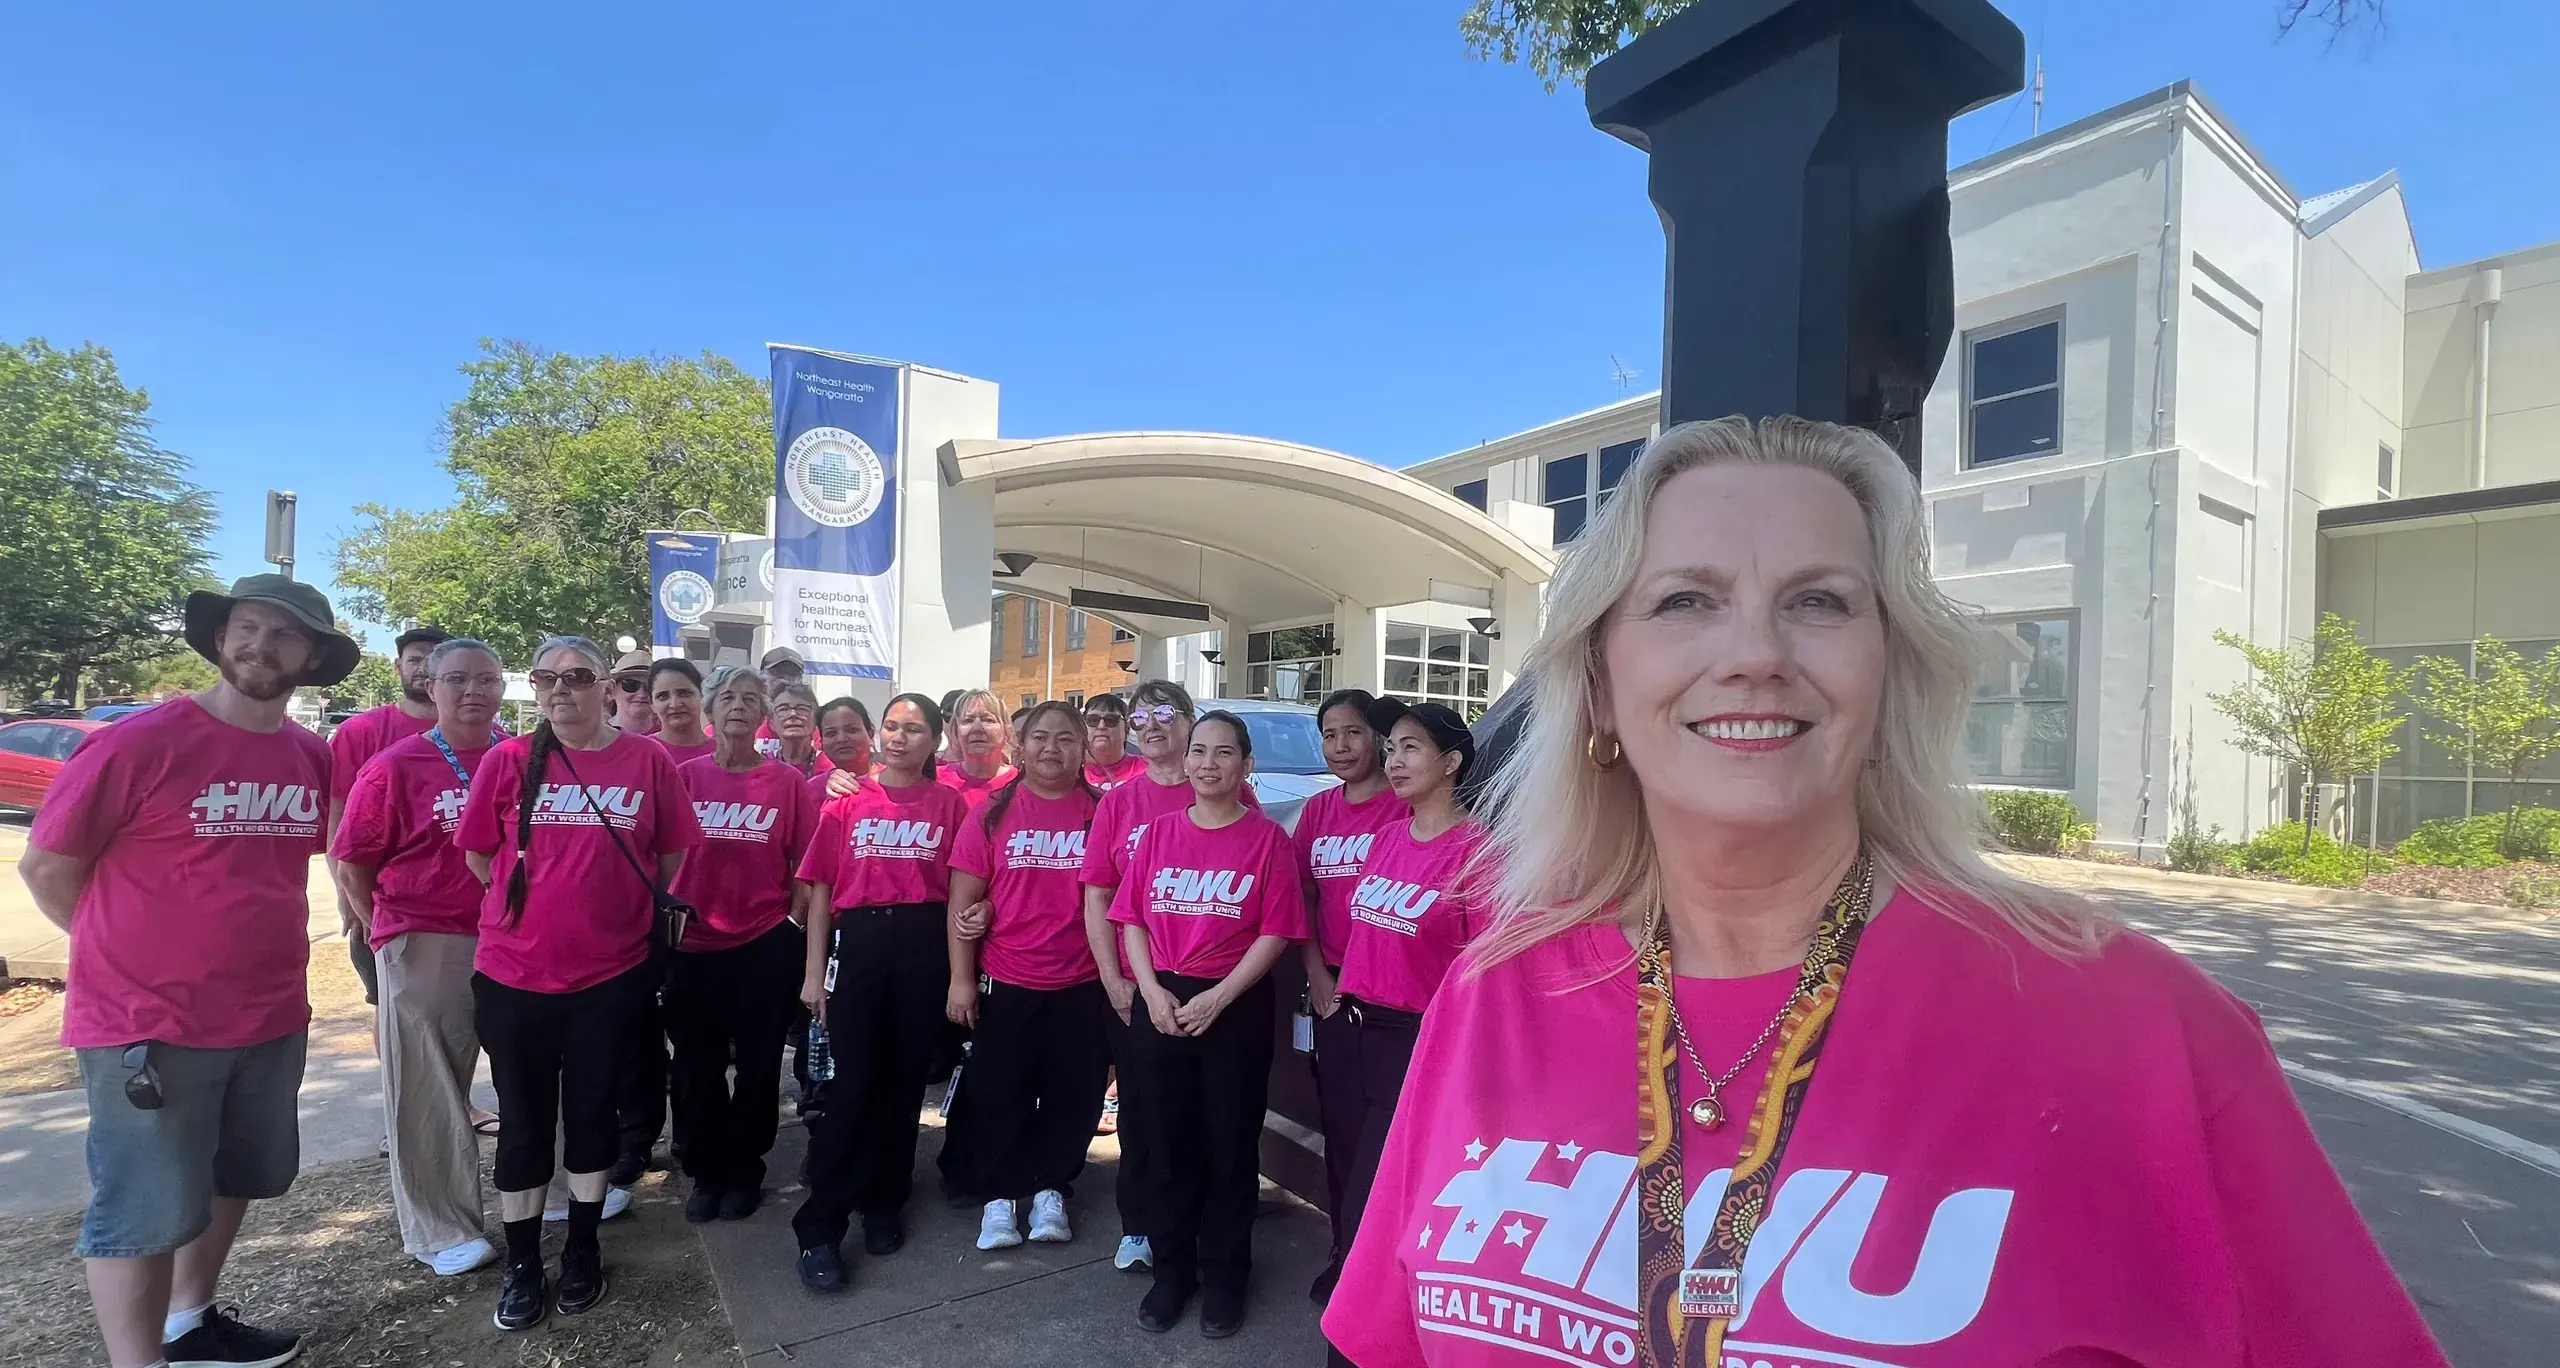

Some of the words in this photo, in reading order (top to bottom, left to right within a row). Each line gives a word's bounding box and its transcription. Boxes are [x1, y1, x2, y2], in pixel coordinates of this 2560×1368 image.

[796, 371, 842, 387] Northeast
[843, 379, 875, 393] Health
[806, 385, 864, 403] Wangaratta
[789, 430, 844, 470] NORTHEAST
[851, 438, 881, 480] HEALTH
[801, 501, 870, 523] WANGARATTA
[798, 587, 869, 604] Exceptional
[801, 603, 866, 618] healthcare
[794, 618, 810, 629] for
[814, 619, 873, 634] Northeast
[795, 635, 871, 648] communities
[192, 782, 319, 822] HWU
[533, 784, 645, 816] HWU
[195, 824, 243, 834] HEALTH
[531, 814, 555, 823] ALTH
[558, 814, 603, 824] WORKER
[609, 817, 637, 829] UNION
[705, 830, 743, 838] WORKERS
[852, 818, 944, 849] HWU
[1008, 859, 1036, 867] HEALTH
[1037, 859, 1073, 867] WORKERS
[1152, 867, 1255, 904] HWU
[1216, 906, 1241, 916] UNION
[1418, 1285, 1542, 1339] HEALTH
[1681, 1304, 1737, 1315] DELEGATE
